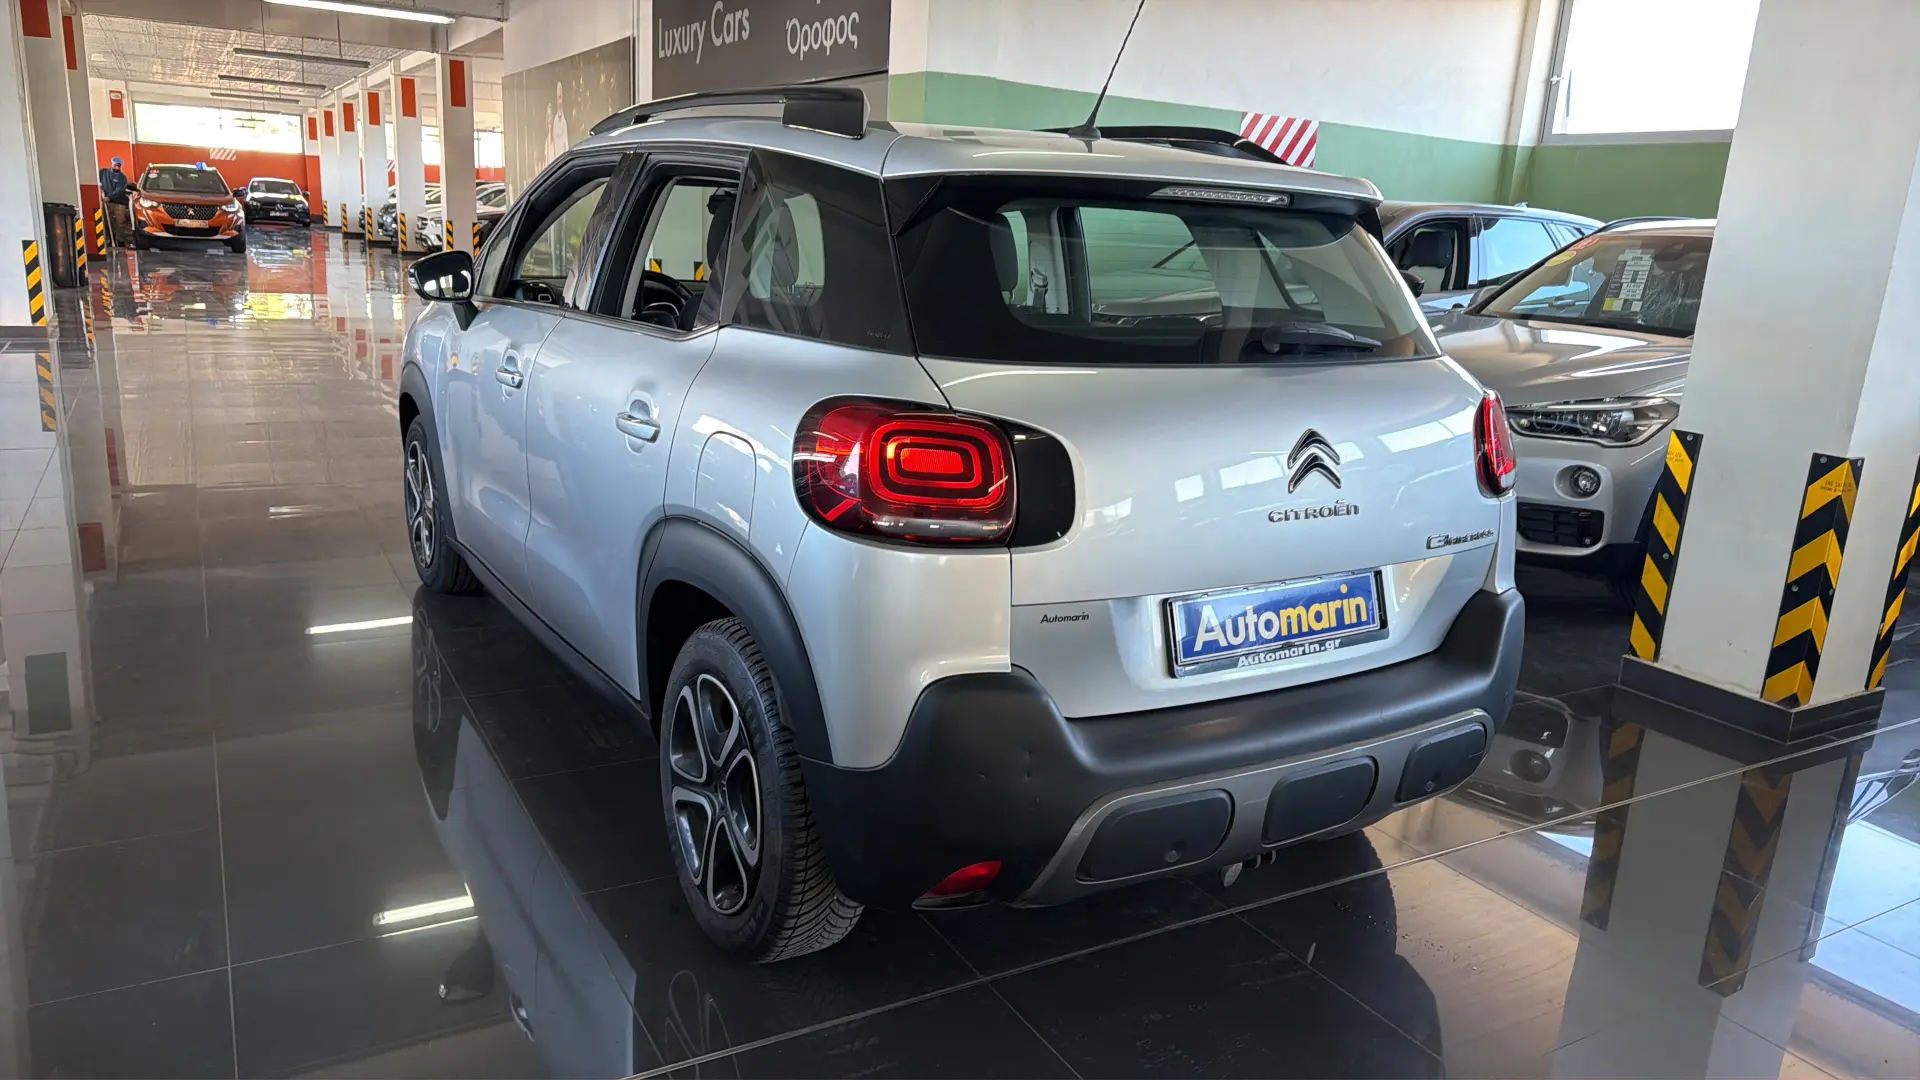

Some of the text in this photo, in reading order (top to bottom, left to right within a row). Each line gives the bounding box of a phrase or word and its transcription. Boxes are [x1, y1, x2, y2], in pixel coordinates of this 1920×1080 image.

[658, 0, 750, 64] Luxury Cars
[785, 11, 860, 61] Όροφος
[1040, 611, 1090, 624] Automarin
[1193, 583, 1368, 652] Automarin
[1237, 638, 1342, 668] Automarin.gr
